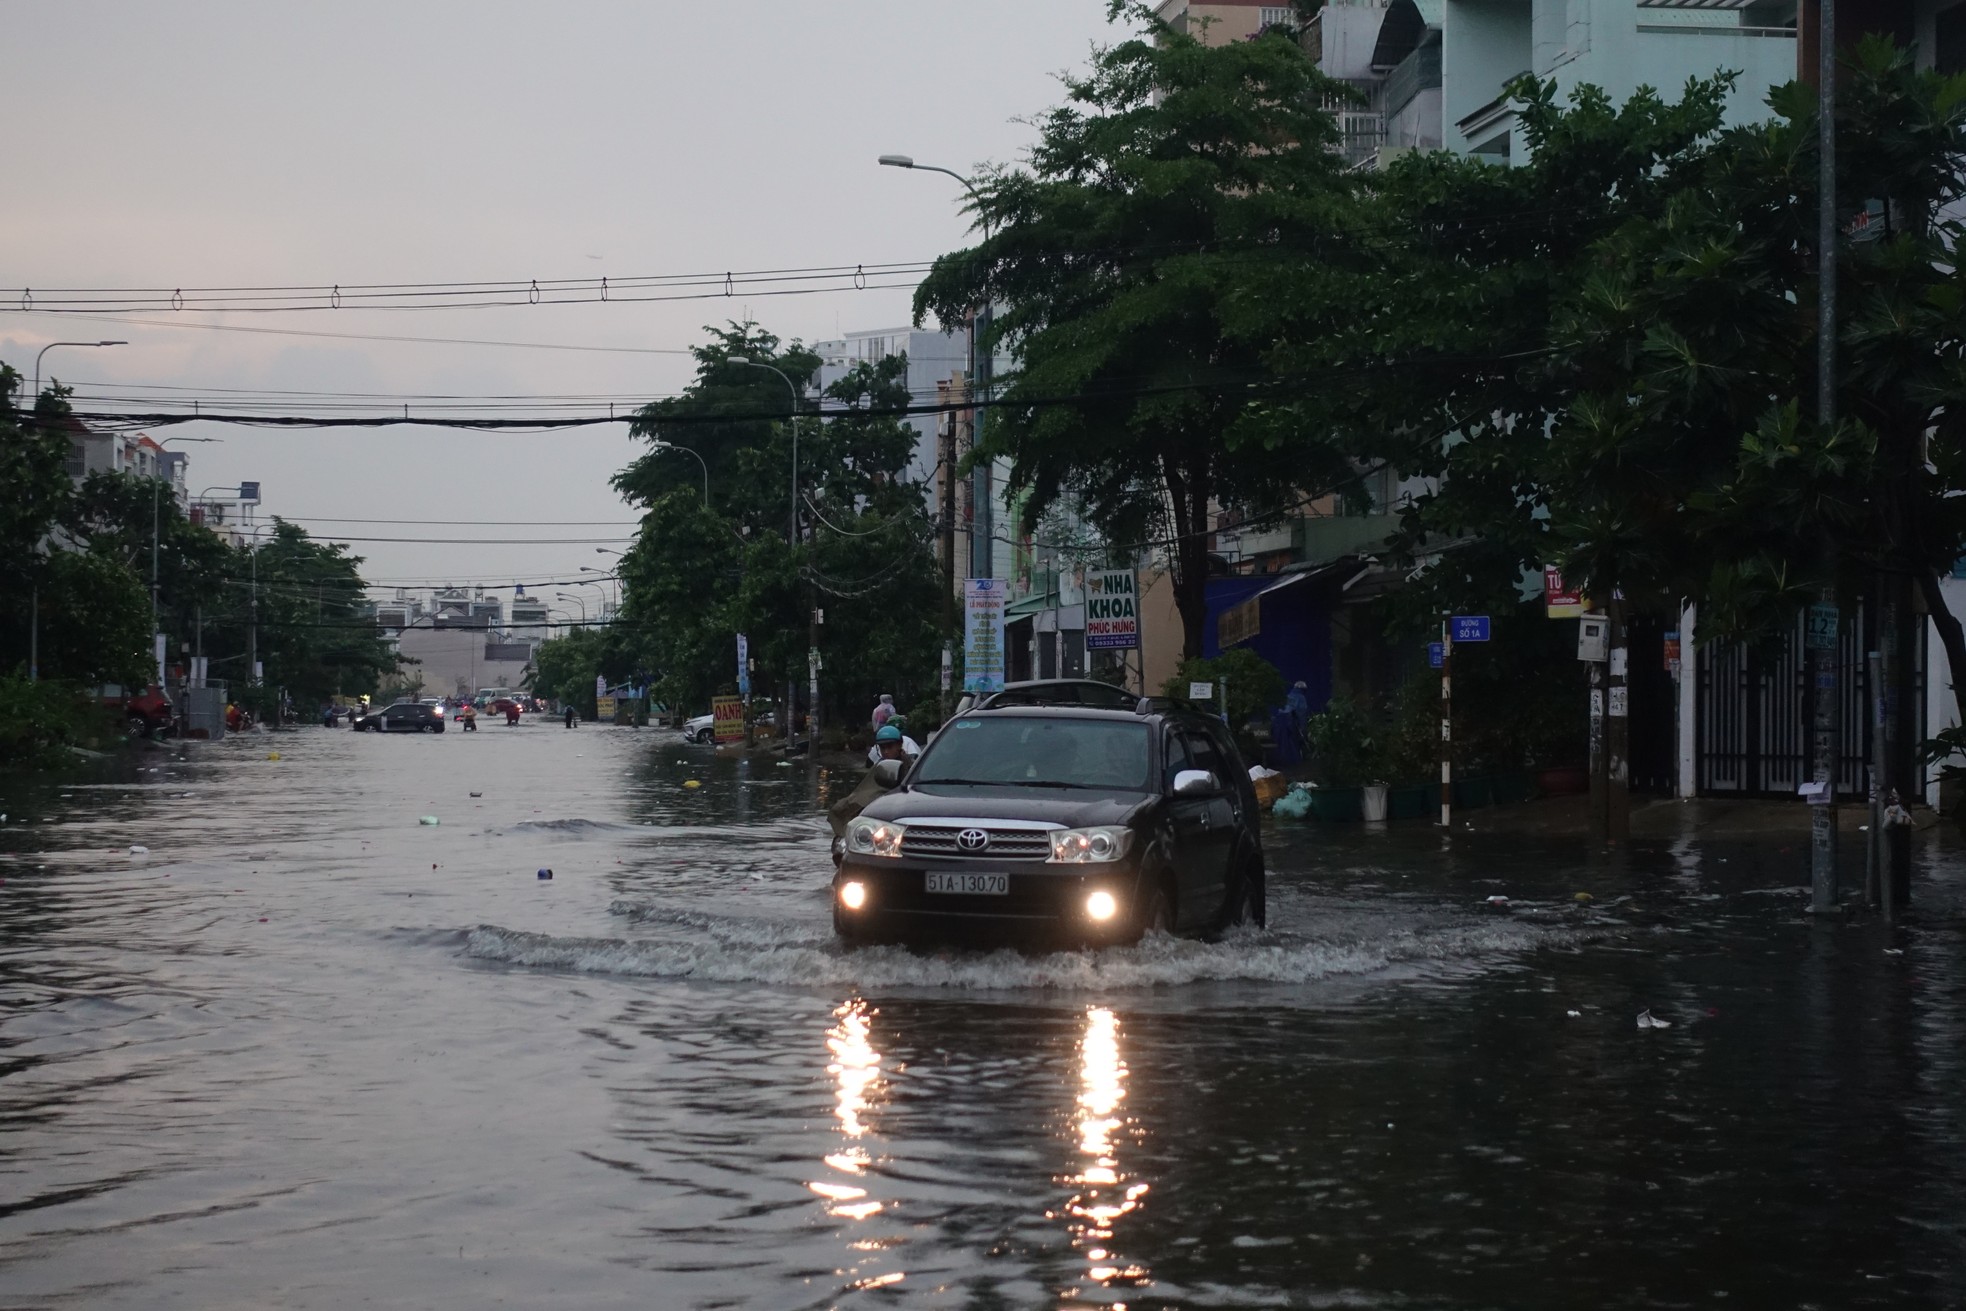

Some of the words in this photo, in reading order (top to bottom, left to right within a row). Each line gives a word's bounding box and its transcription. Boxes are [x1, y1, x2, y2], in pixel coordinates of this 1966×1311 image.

[1104, 574, 1133, 594] NHA
[1088, 597, 1135, 619] KHOA
[1088, 619, 1110, 634] PHÚC
[1112, 619, 1135, 633] HƯNG
[1460, 619, 1479, 627] ĐƯỜNG
[1459, 627, 1470, 638] SỐ
[1471, 629, 1481, 638] 1A
[715, 703, 742, 721] OANH
[928, 874, 1006, 892] 51A-130.70
